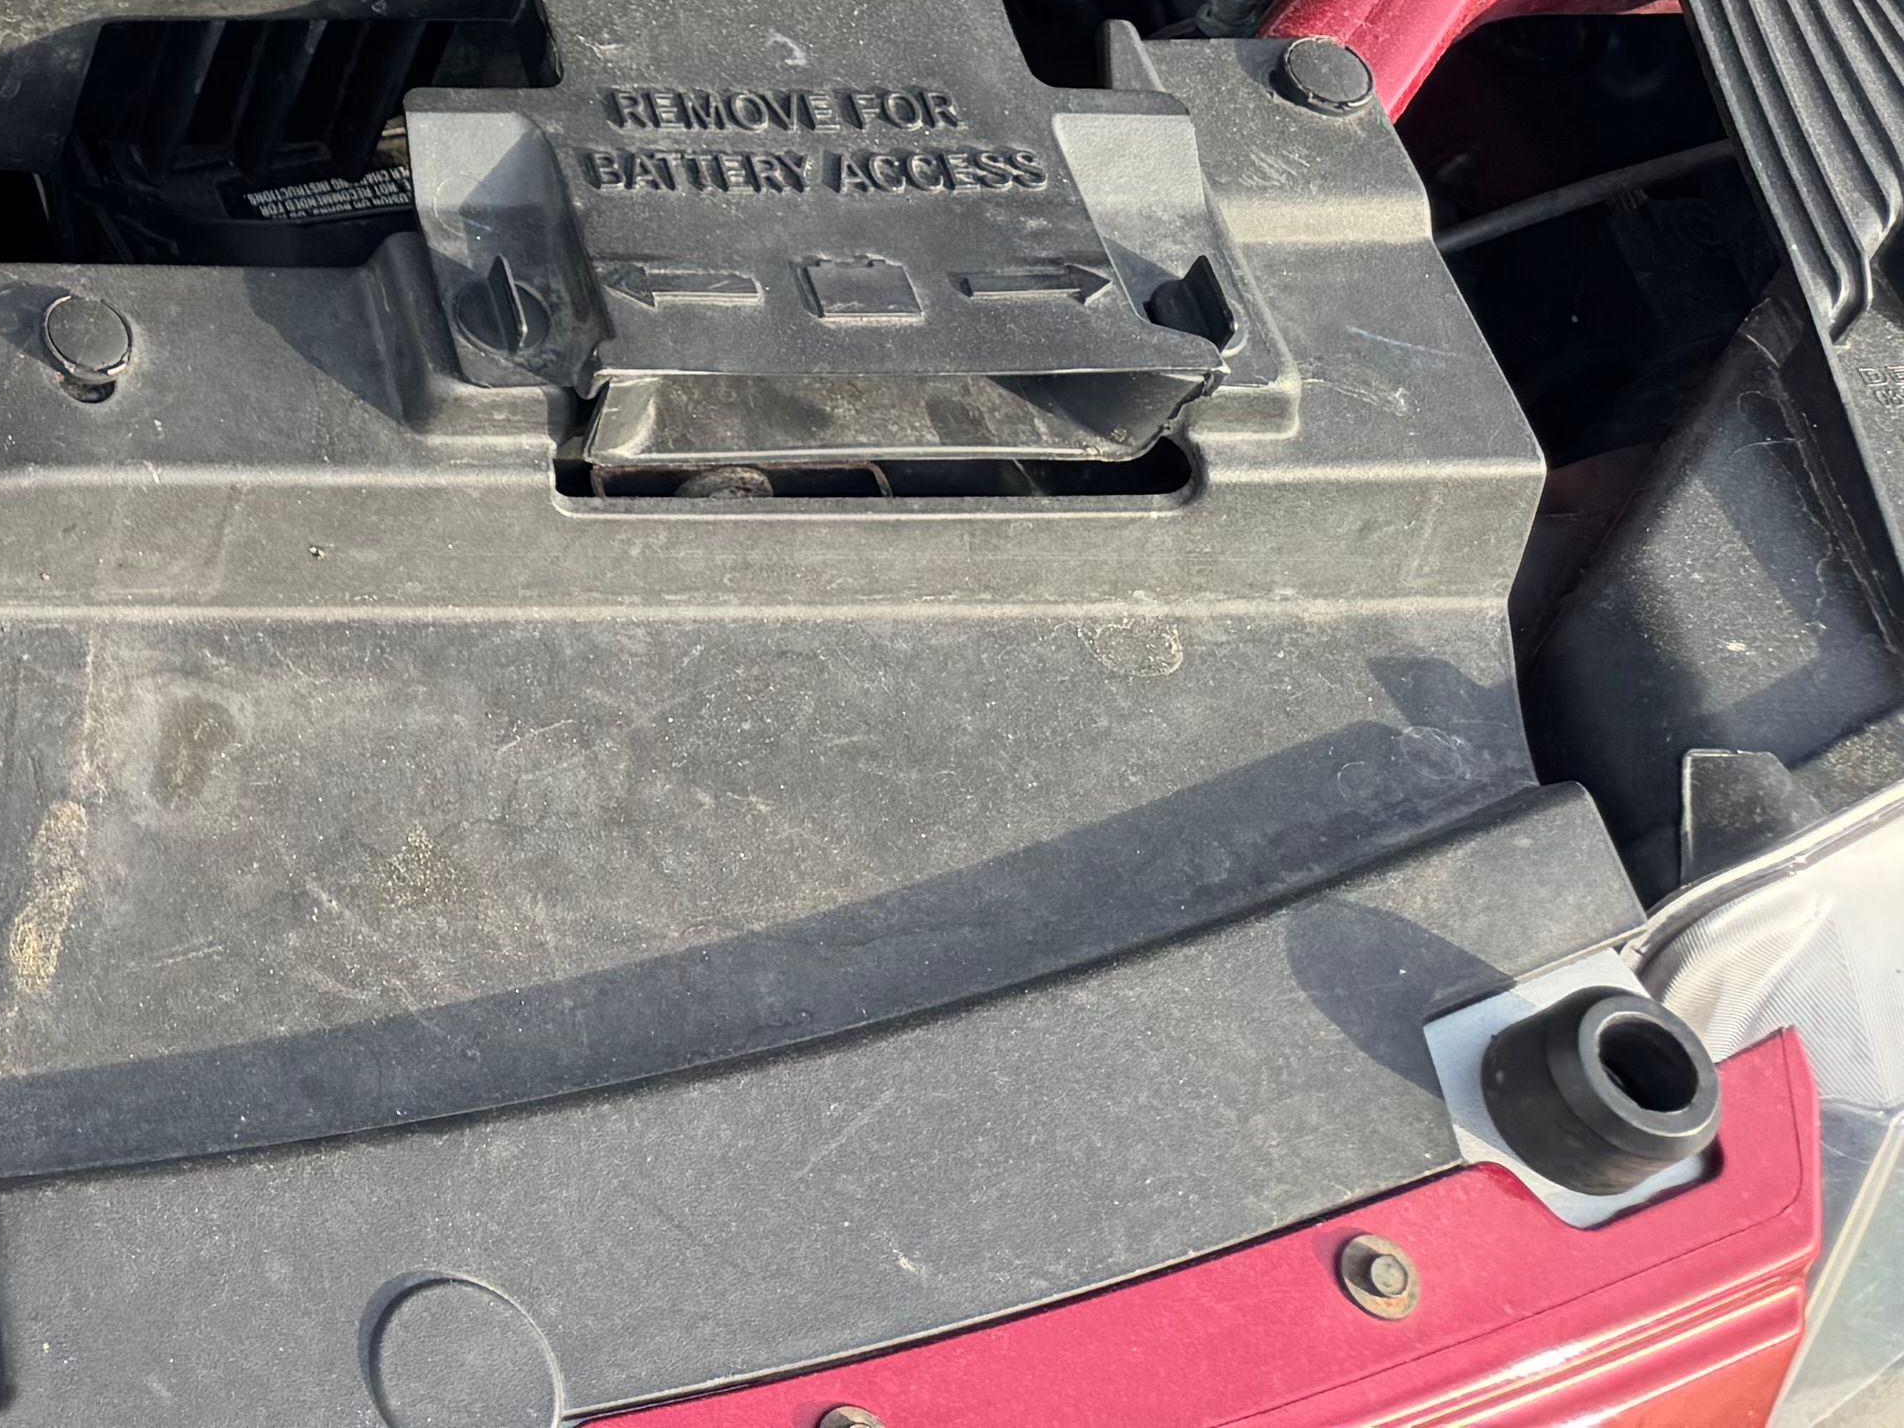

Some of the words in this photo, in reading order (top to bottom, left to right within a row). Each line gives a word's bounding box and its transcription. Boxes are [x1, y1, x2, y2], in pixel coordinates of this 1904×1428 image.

[607, 88, 843, 134] REMOVE
[849, 88, 968, 132] FOR
[583, 149, 814, 194] BATTERY
[822, 147, 1052, 194] ACCESS
[285, 185, 374, 211] RECOMMENDED
